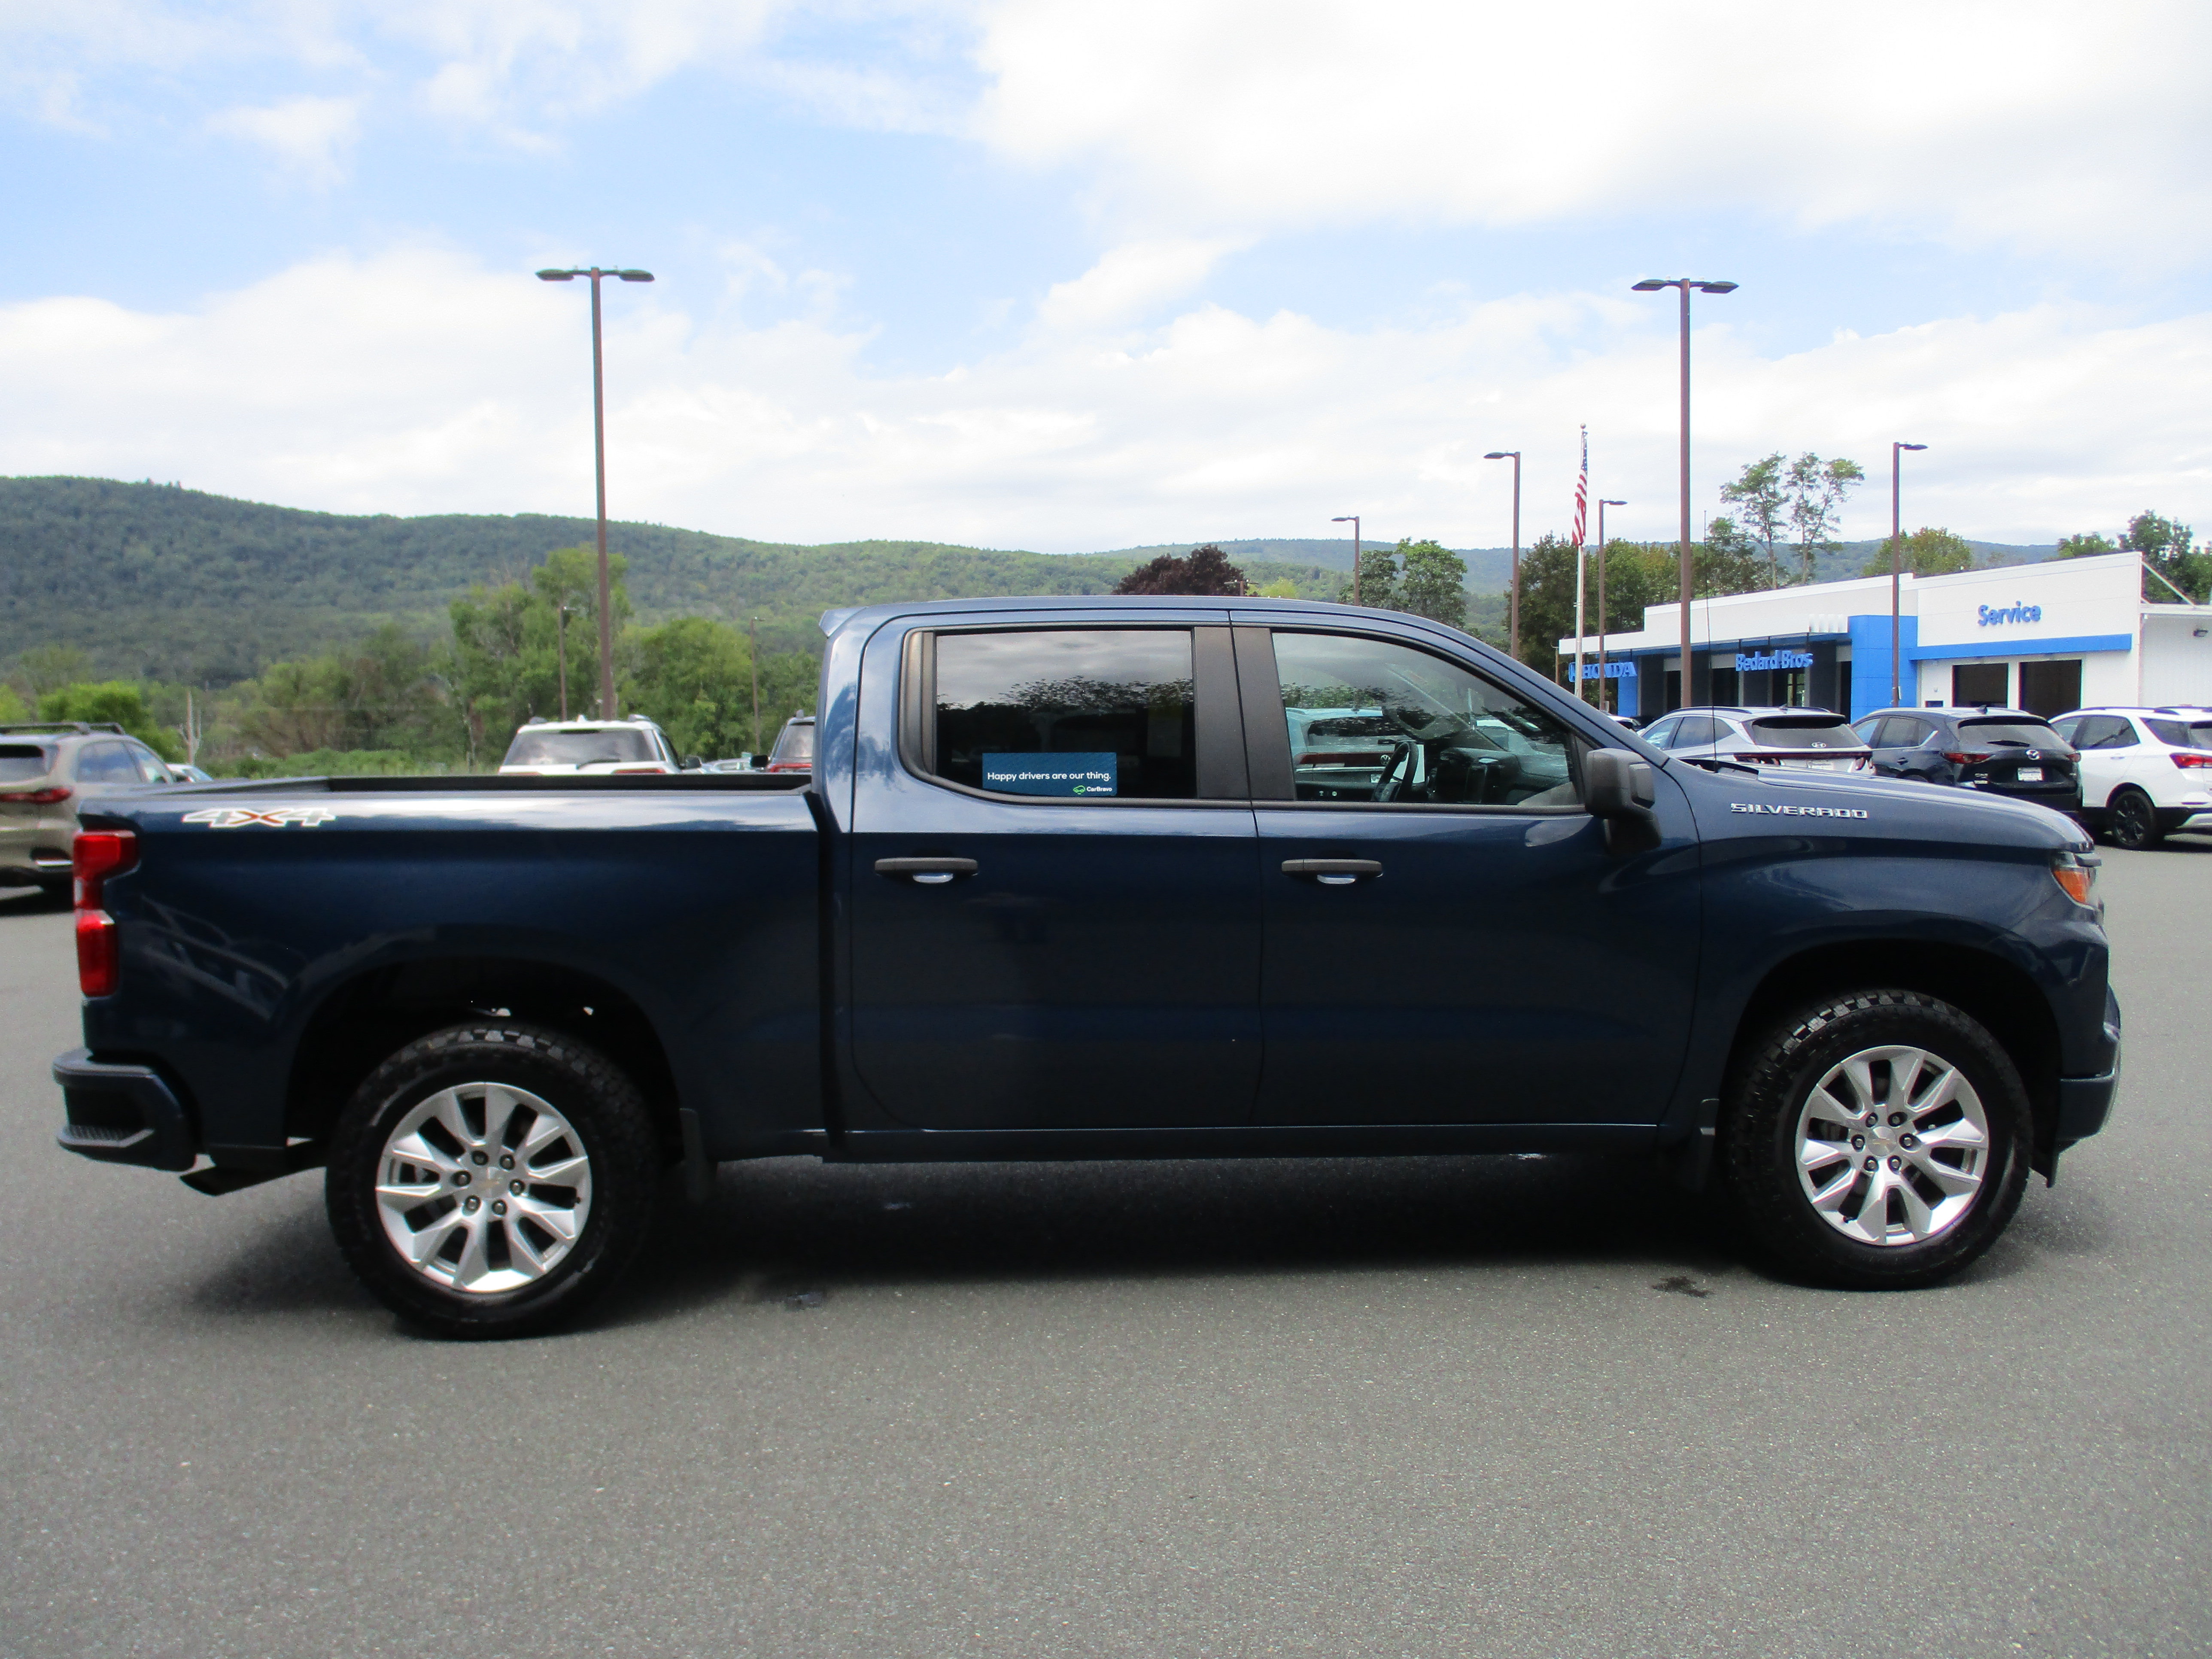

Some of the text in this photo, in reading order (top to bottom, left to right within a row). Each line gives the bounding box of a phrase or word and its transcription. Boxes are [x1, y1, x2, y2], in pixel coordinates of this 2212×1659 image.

[1978, 601, 2041, 626] Service
[1736, 650, 1781, 671] Bedard
[1581, 662, 1638, 679] HONDA
[988, 772, 1017, 781] Happy
[1086, 772, 1111, 781] thing.
[1730, 802, 1868, 819] SILVERADO
